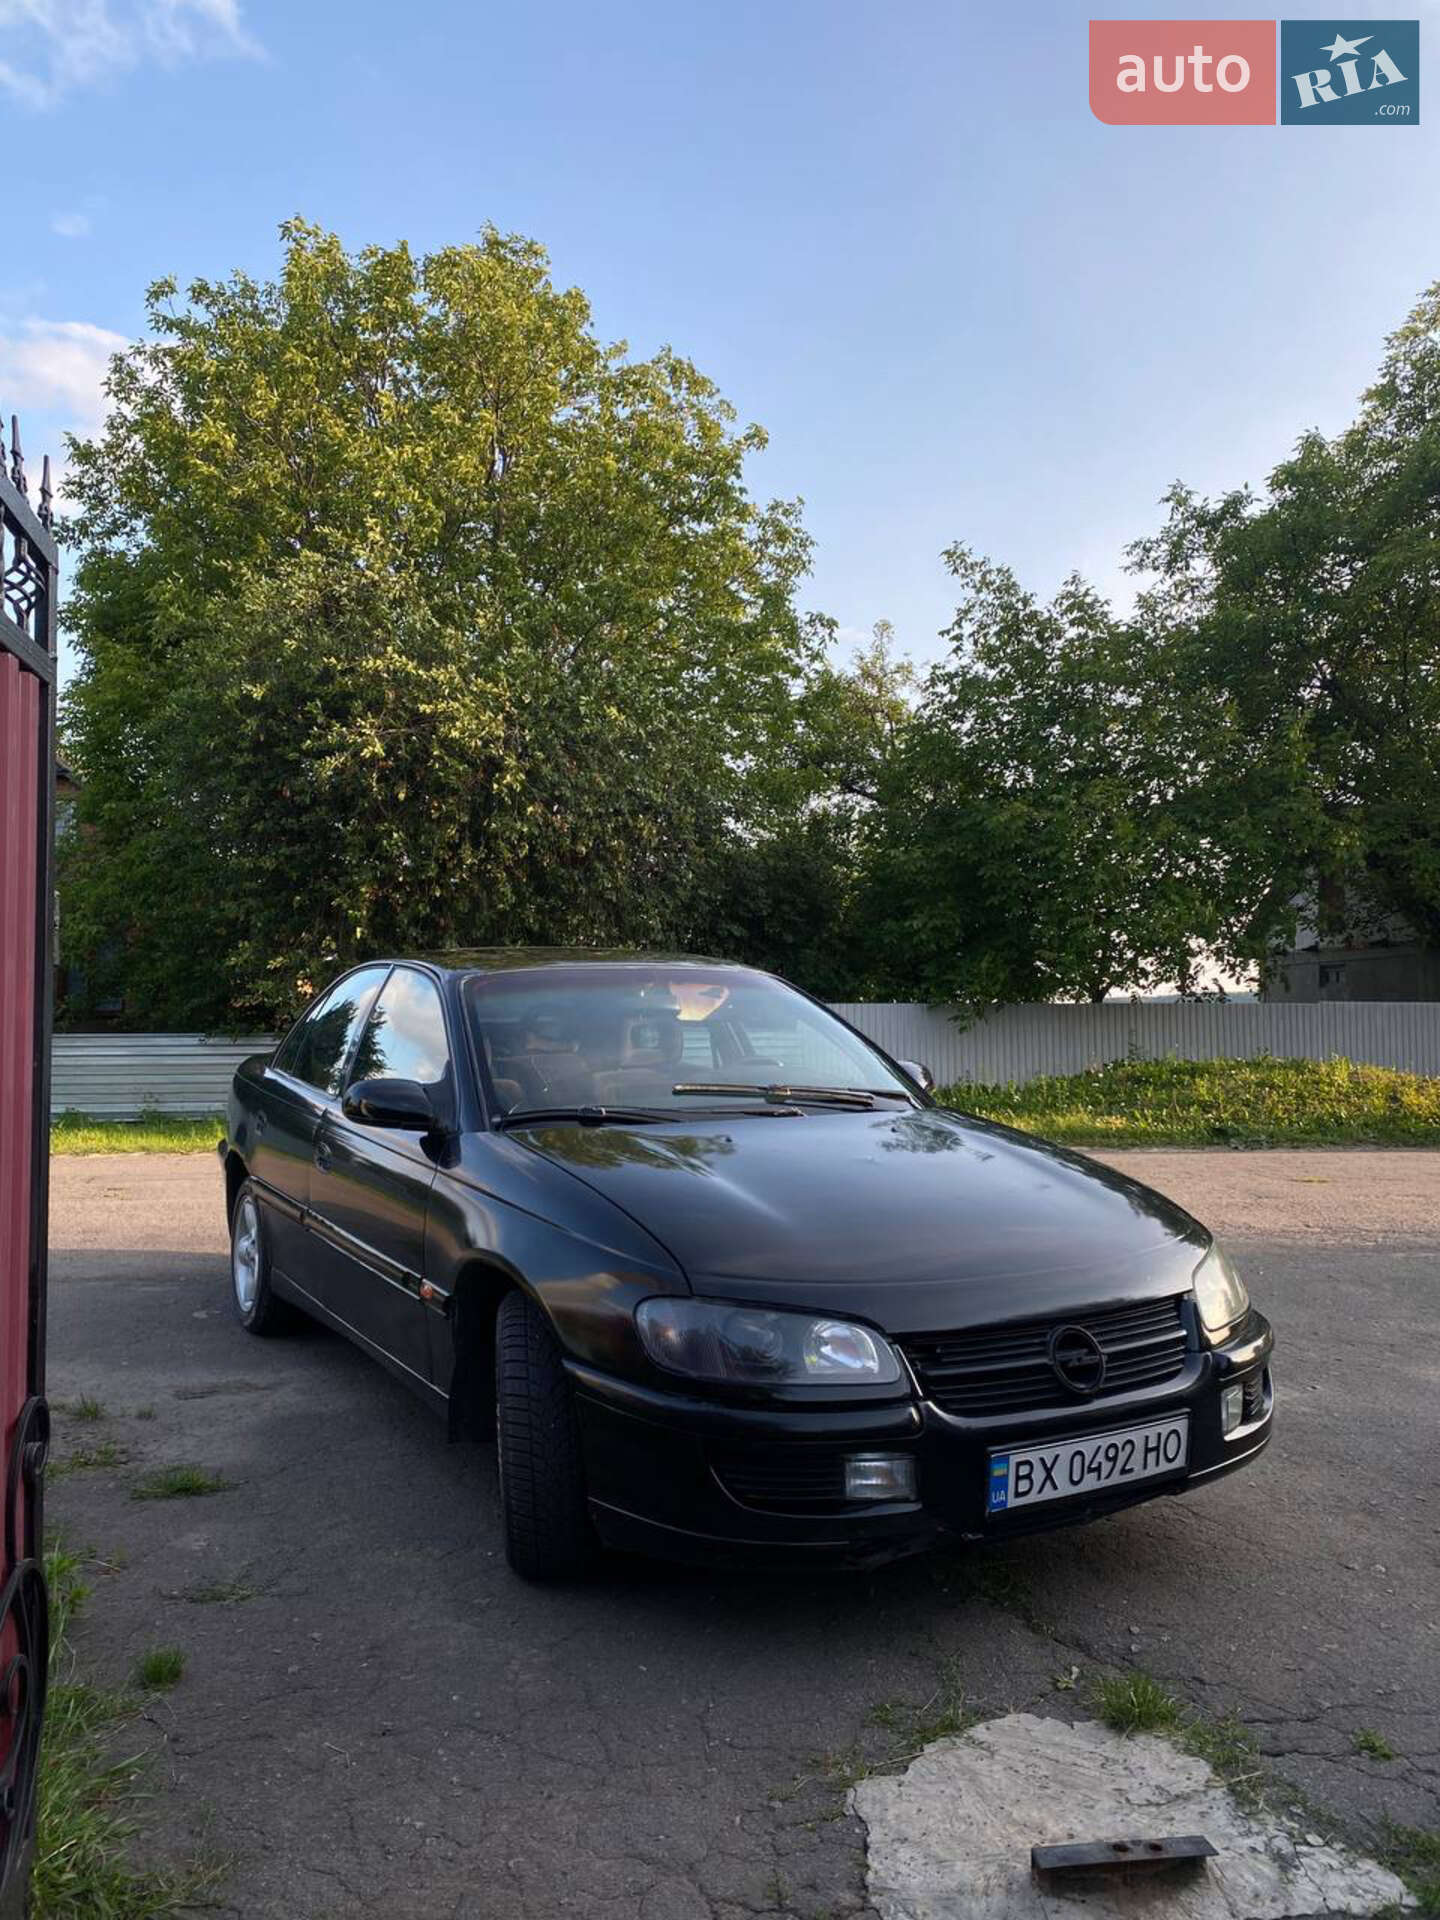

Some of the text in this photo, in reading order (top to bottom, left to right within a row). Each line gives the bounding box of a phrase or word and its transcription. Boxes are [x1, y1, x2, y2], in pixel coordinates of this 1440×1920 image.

[1013, 1429, 1181, 1498] BX 0492 HO
[991, 1491, 1006, 1504] UA
